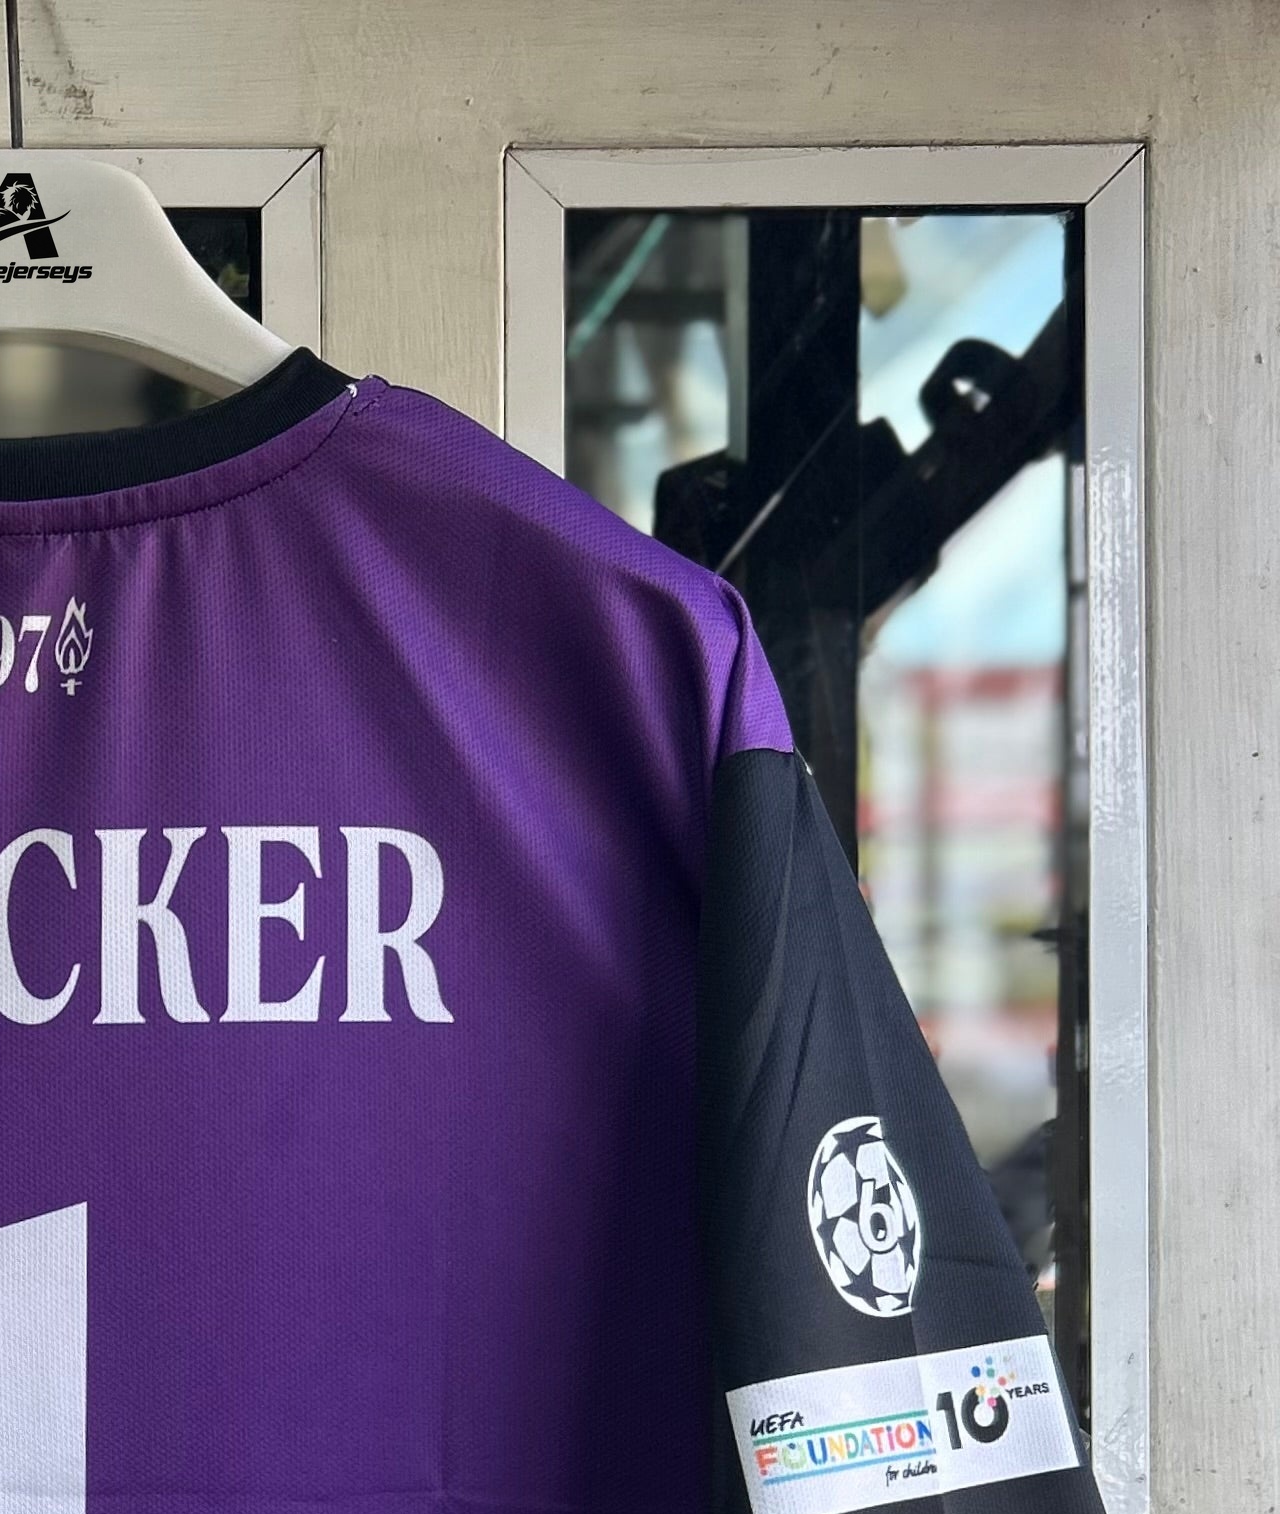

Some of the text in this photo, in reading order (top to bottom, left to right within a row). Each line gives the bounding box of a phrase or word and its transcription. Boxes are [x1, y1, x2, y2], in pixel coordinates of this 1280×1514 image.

[858, 1180, 897, 1254] 6
[749, 1410, 806, 1437] UEFA
[936, 1382, 1050, 1451] 10 YEARS
[754, 1419, 933, 1476] FOUNDATION
[885, 1465, 900, 1487] for
